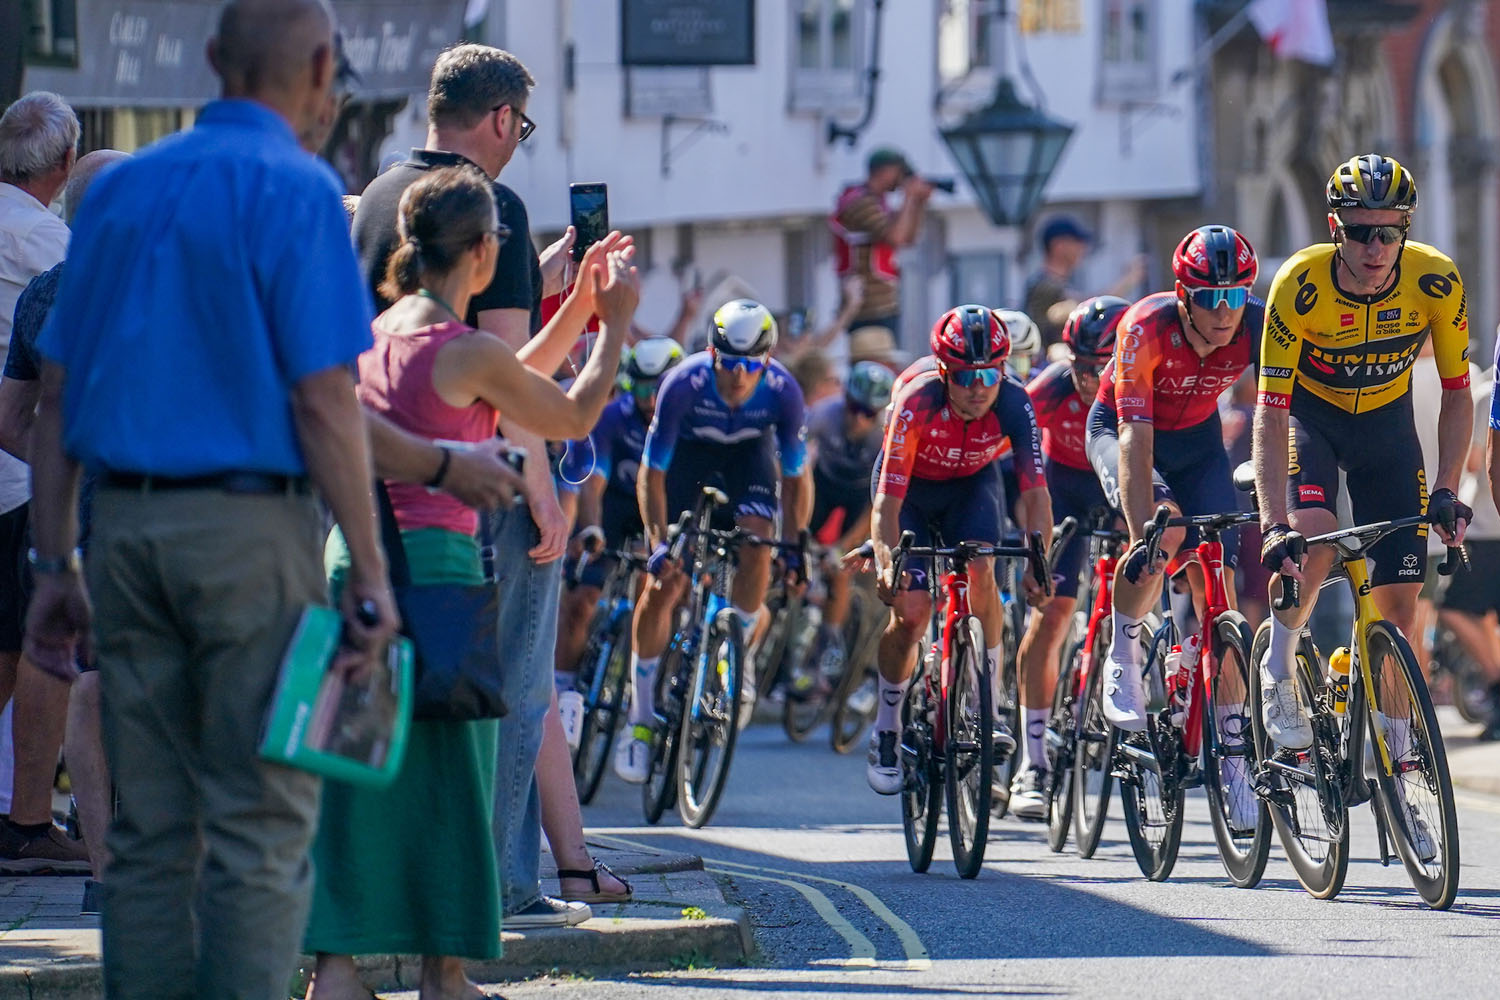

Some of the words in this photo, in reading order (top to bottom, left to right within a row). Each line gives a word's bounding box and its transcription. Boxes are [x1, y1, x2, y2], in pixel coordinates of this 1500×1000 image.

[1334, 298, 1360, 310] JUMBO
[1269, 303, 1297, 343] JUMBO
[1376, 321, 1400, 329] lease
[1267, 322, 1290, 351] VISMA
[1119, 322, 1145, 383] INEOS
[1309, 343, 1418, 364] JUMBO
[1344, 354, 1414, 377] VISMA
[1157, 375, 1238, 388] INEOS
[1257, 393, 1287, 407] EMA
[1023, 402, 1044, 475] GRENADIER
[923, 445, 996, 461] INEOS
